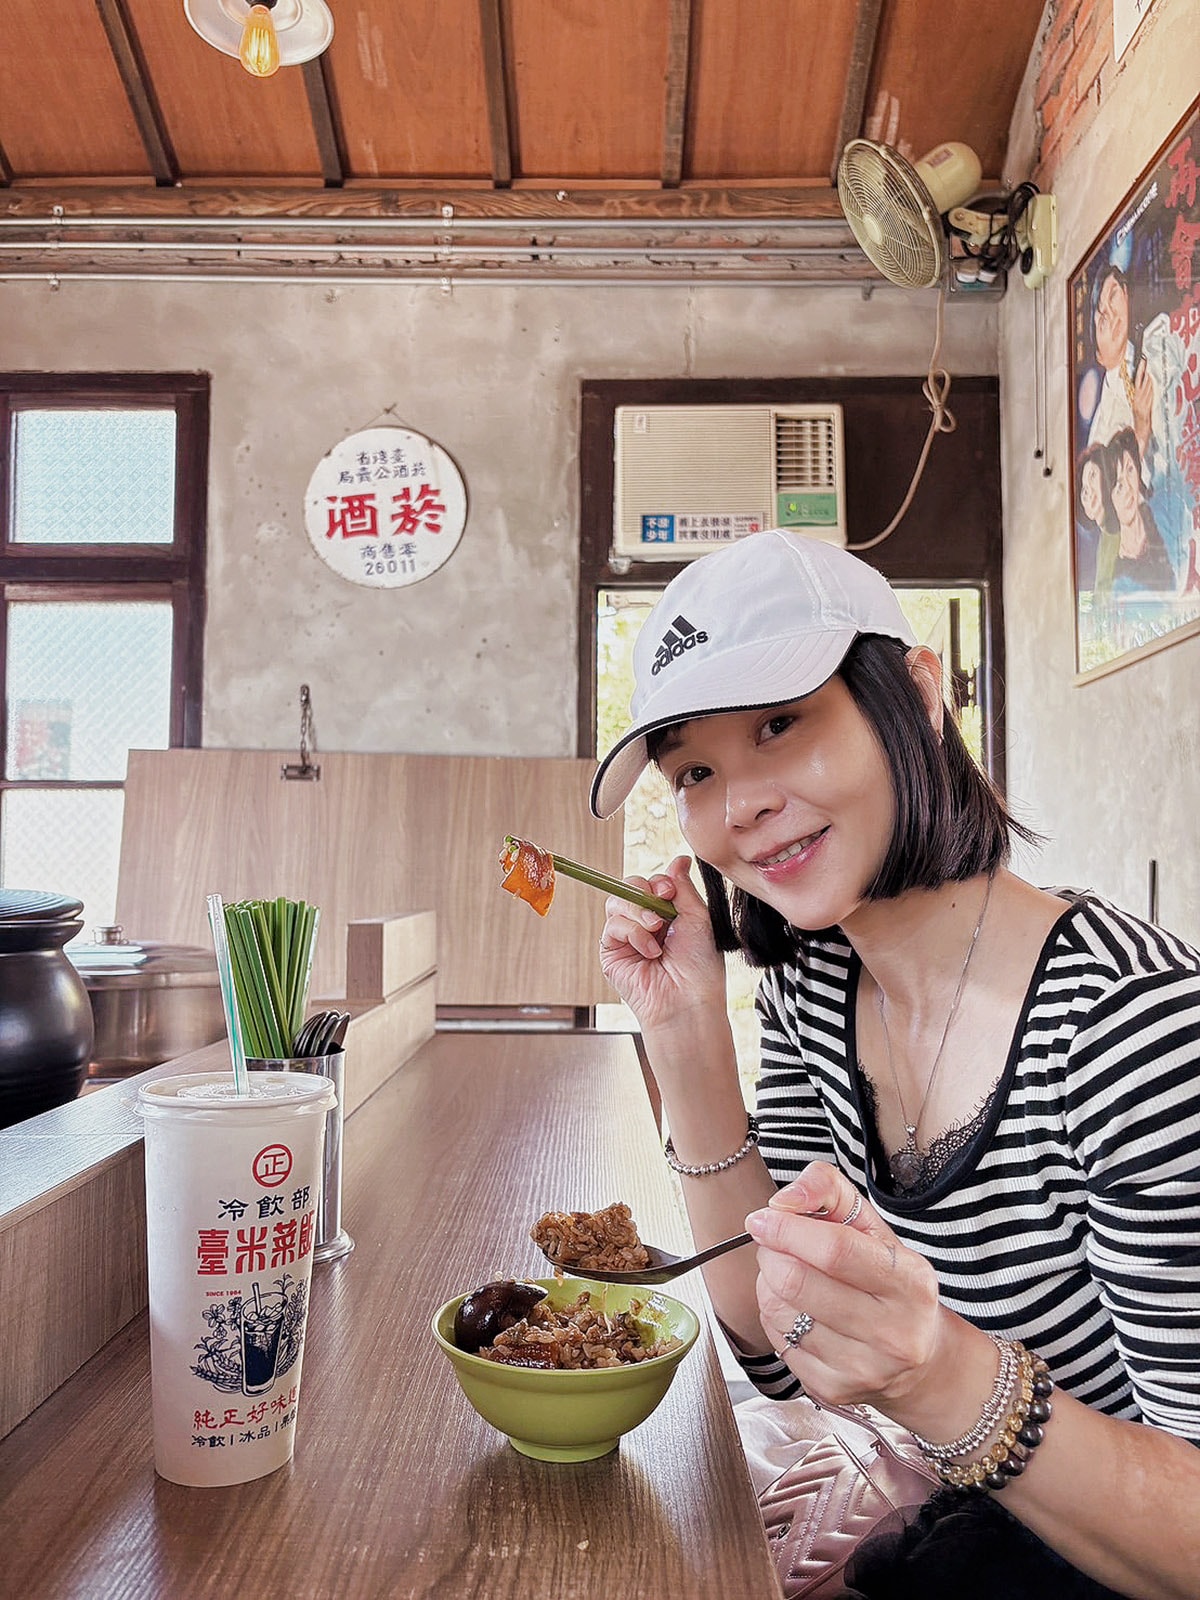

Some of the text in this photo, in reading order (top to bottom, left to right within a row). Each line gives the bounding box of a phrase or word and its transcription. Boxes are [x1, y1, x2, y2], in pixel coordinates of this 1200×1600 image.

[365, 560, 416, 576] 26011
[651, 631, 709, 677] adidas
[256, 1150, 291, 1181] 正
[217, 1185, 311, 1221] 冷飲部
